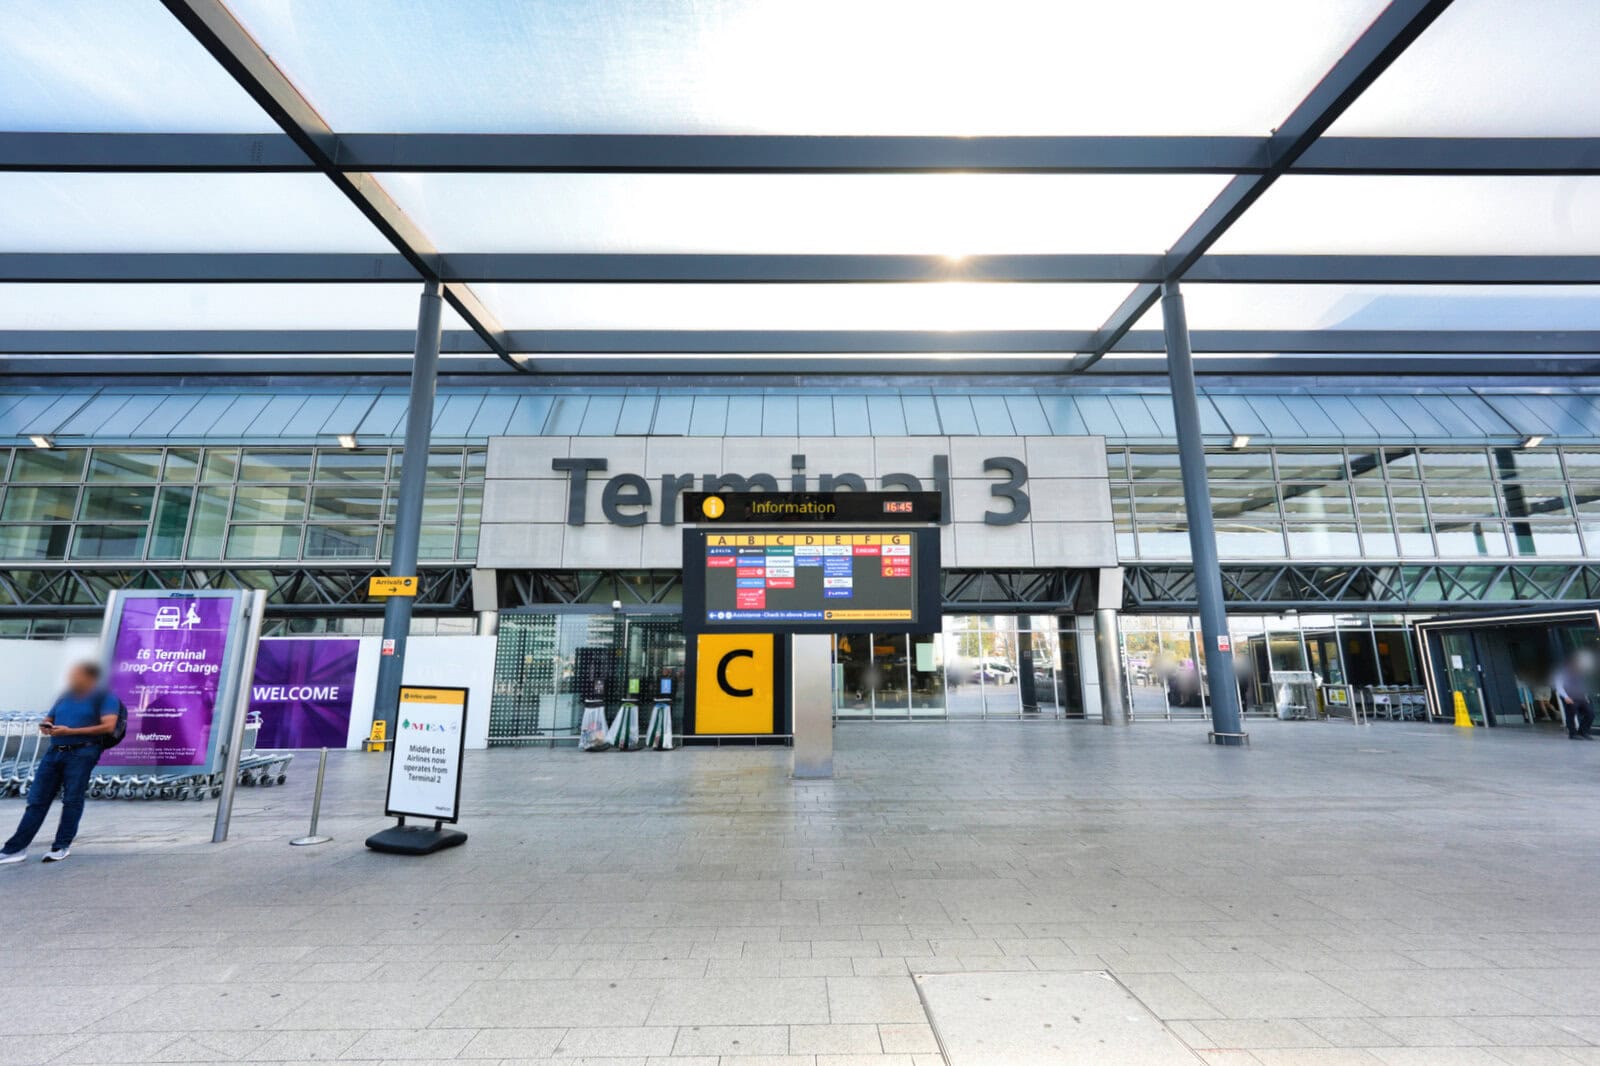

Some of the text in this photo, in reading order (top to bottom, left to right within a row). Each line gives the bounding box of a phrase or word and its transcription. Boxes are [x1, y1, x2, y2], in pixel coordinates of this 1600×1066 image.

[552, 455, 1031, 527] Teril 3
[752, 500, 836, 514] Information
[718, 536, 727, 545] A
[747, 536, 755, 545] B
[776, 536, 784, 545] C
[805, 536, 814, 545] D
[835, 536, 841, 545] E
[865, 536, 871, 545] F
[892, 535, 900, 545] G
[136, 649, 206, 660] £6 Terminal
[120, 661, 218, 676] Drop-Off Charge
[717, 649, 754, 698] C
[253, 686, 340, 701] WELCOME
[136, 733, 172, 741] Heathrow
[409, 745, 446, 755] Middle East
[407, 754, 430, 763] Airlines
[432, 765, 448, 774] from
[408, 773, 436, 783] Terminal
